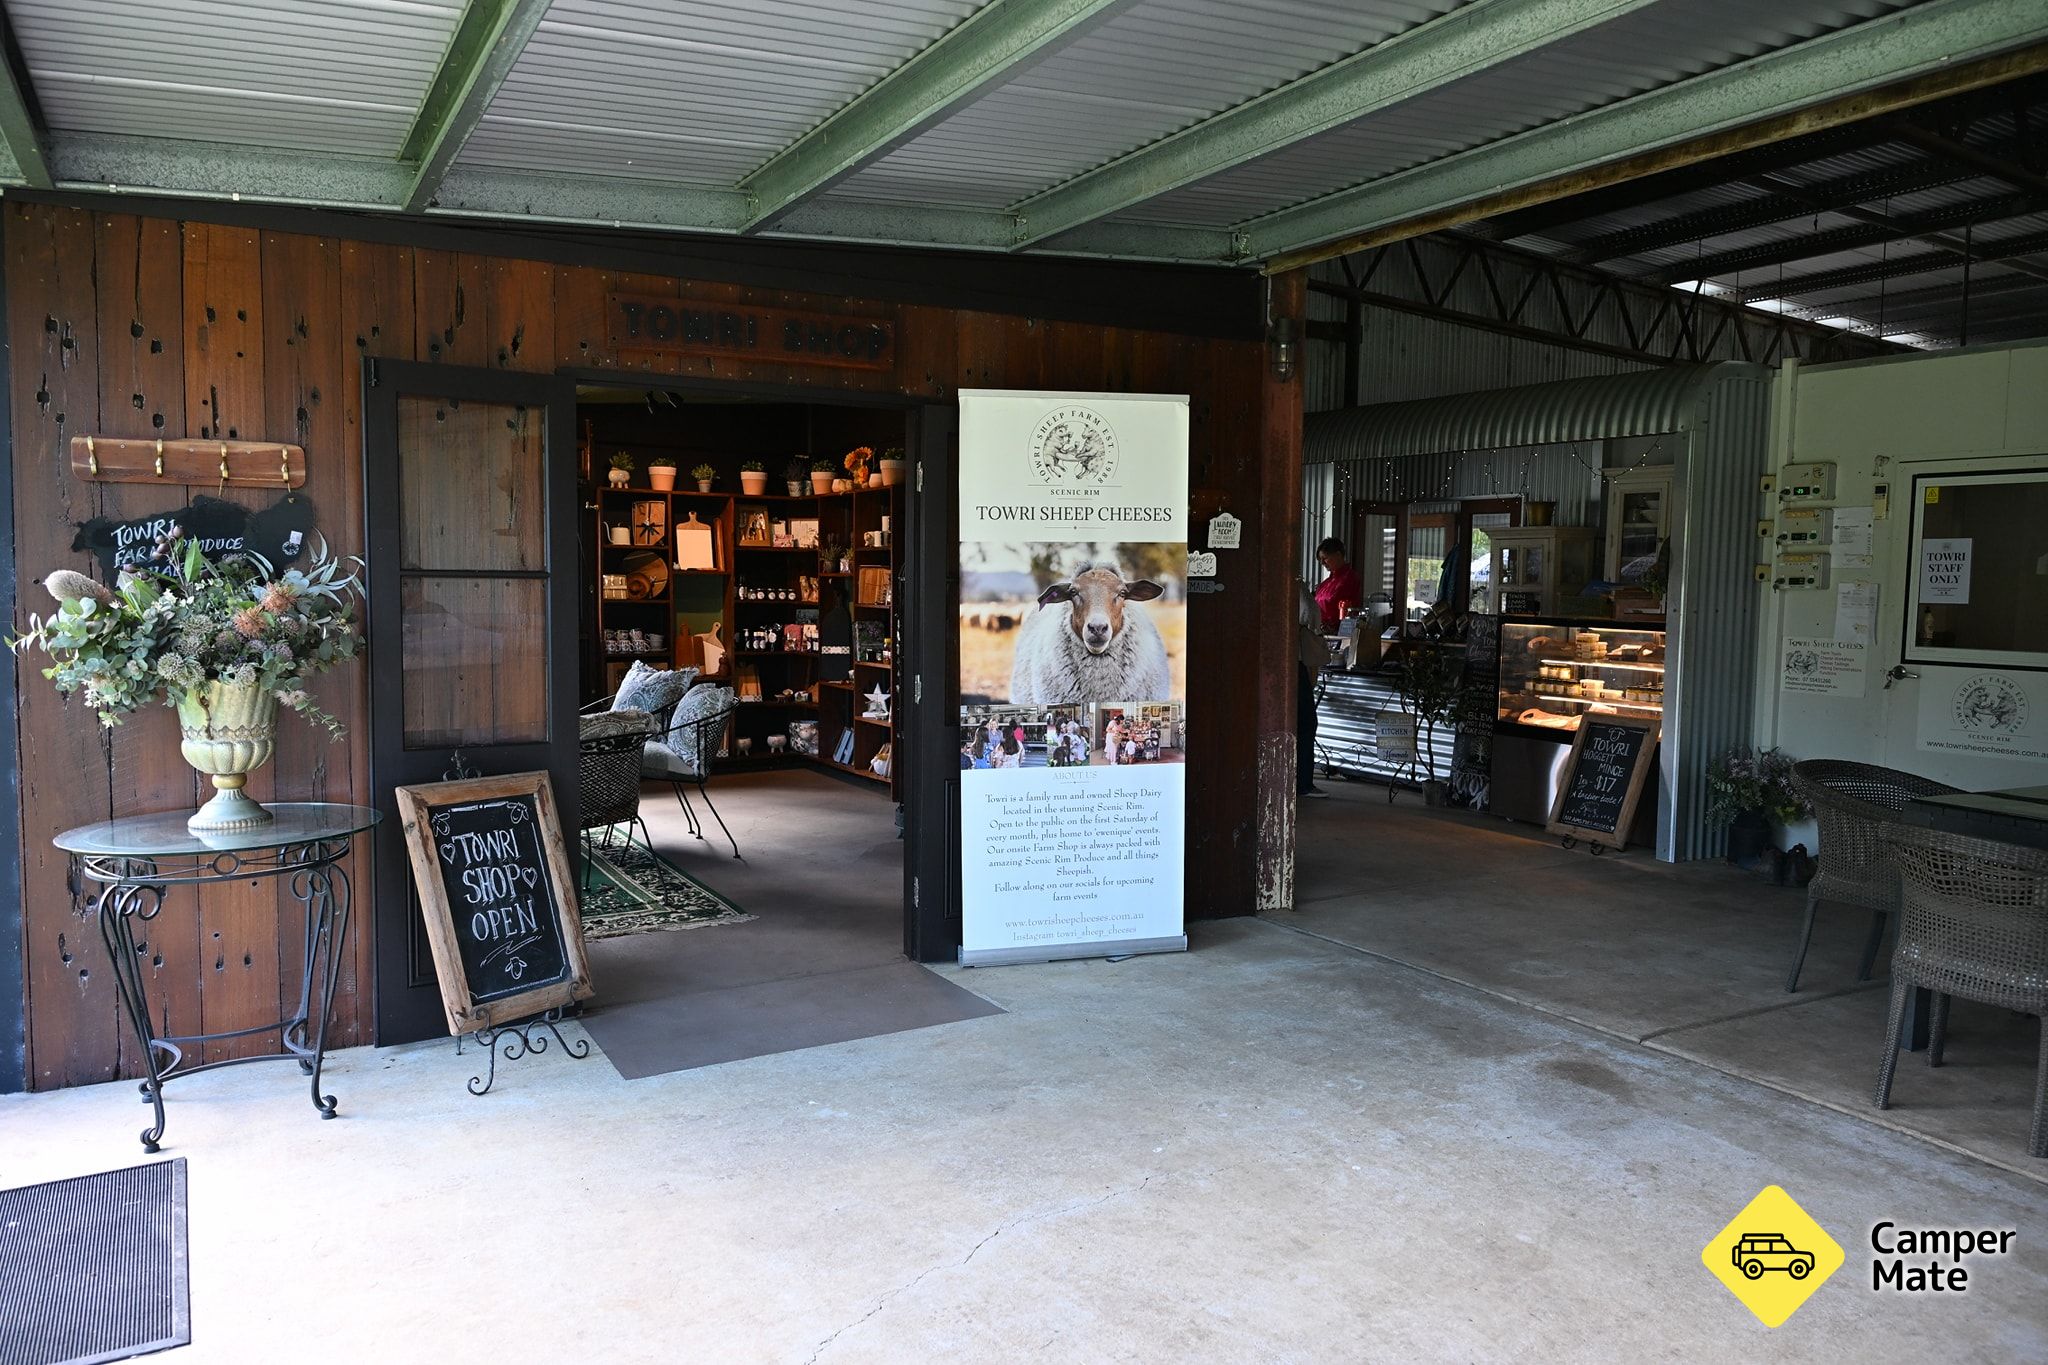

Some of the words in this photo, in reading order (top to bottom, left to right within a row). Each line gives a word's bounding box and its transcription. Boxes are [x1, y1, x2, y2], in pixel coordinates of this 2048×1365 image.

[621, 302, 757, 349] TOWRI
[783, 319, 890, 361] SHOP
[1036, 412, 1065, 440] SHEEP
[1071, 410, 1101, 426] FARM
[1033, 446, 1050, 484] TOWRI
[976, 506, 1035, 521] TOWRI
[1040, 506, 1094, 521] SHEEP
[1097, 507, 1172, 522] CHEESES
[1926, 552, 1967, 562] TOWRI
[1928, 563, 1965, 573] STAFF
[1929, 575, 1961, 585] ONLY
[1381, 727, 1408, 736] KITCHEN
[1968, 734, 1994, 742] SCENIC
[1593, 737, 1630, 757] TOWRI
[1582, 749, 1617, 765] HOGGETT
[1053, 771, 1083, 781] ABOUT
[1085, 770, 1098, 779] US
[1596, 763, 1626, 778] MINCE
[1594, 774, 1617, 793] $17
[985, 793, 1008, 804] Towri
[1010, 794, 1017, 803] is
[1026, 791, 1051, 803] family
[1070, 789, 1085, 800] and
[1086, 788, 1112, 799] owned
[1114, 787, 1138, 800] Sheep
[1140, 788, 1163, 798] Dairy
[1003, 804, 1031, 815] located
[1034, 805, 1042, 814] in
[1044, 803, 1057, 813] the
[1059, 804, 1095, 813] stunning
[1097, 801, 1124, 811] Scenic
[1126, 801, 1144, 810] Rim.
[989, 819, 1012, 831] Open
[1015, 820, 1024, 828] to
[1026, 816, 1039, 827] the
[1040, 815, 1065, 828] public
[1080, 814, 1093, 825] the
[1095, 813, 1111, 824] first
[1113, 812, 1149, 824] Saturday
[1149, 811, 1159, 822] of
[1009, 829, 1039, 841] month,
[1041, 829, 1058, 841] plus
[1060, 828, 1082, 839] home
[1084, 829, 1093, 837] to
[1135, 826, 1161, 836] events.
[452, 829, 521, 869] TOWRI
[986, 845, 1004, 855] Our
[1006, 845, 1031, 854] onsite
[1033, 842, 1055, 852] Farm
[1057, 840, 1078, 852] Shop
[1080, 841, 1087, 850] is
[1089, 839, 1113, 851] always
[1116, 836, 1142, 850] packed
[1144, 836, 1161, 846] with
[988, 857, 1023, 867] amazing
[1025, 856, 1052, 865] Scenic
[1053, 854, 1071, 864] Rim
[1073, 851, 1105, 863] Produce
[1106, 850, 1122, 861] and
[1123, 849, 1133, 860] all
[1135, 849, 1159, 860] things
[1056, 864, 1094, 877] Sheepish.
[462, 863, 521, 906] SHOP
[994, 882, 1021, 893] Follow
[1022, 880, 1045, 892] along
[1075, 876, 1101, 888] socials
[1102, 875, 1115, 886] for
[1116, 877, 1154, 888] upcoming
[1052, 891, 1072, 902] farm
[1073, 892, 1098, 901] events
[472, 899, 540, 941] OPEN
[1004, 911, 1144, 928] www.towrisheepcheeses.com.au
[1013, 929, 1054, 943] Instagram
